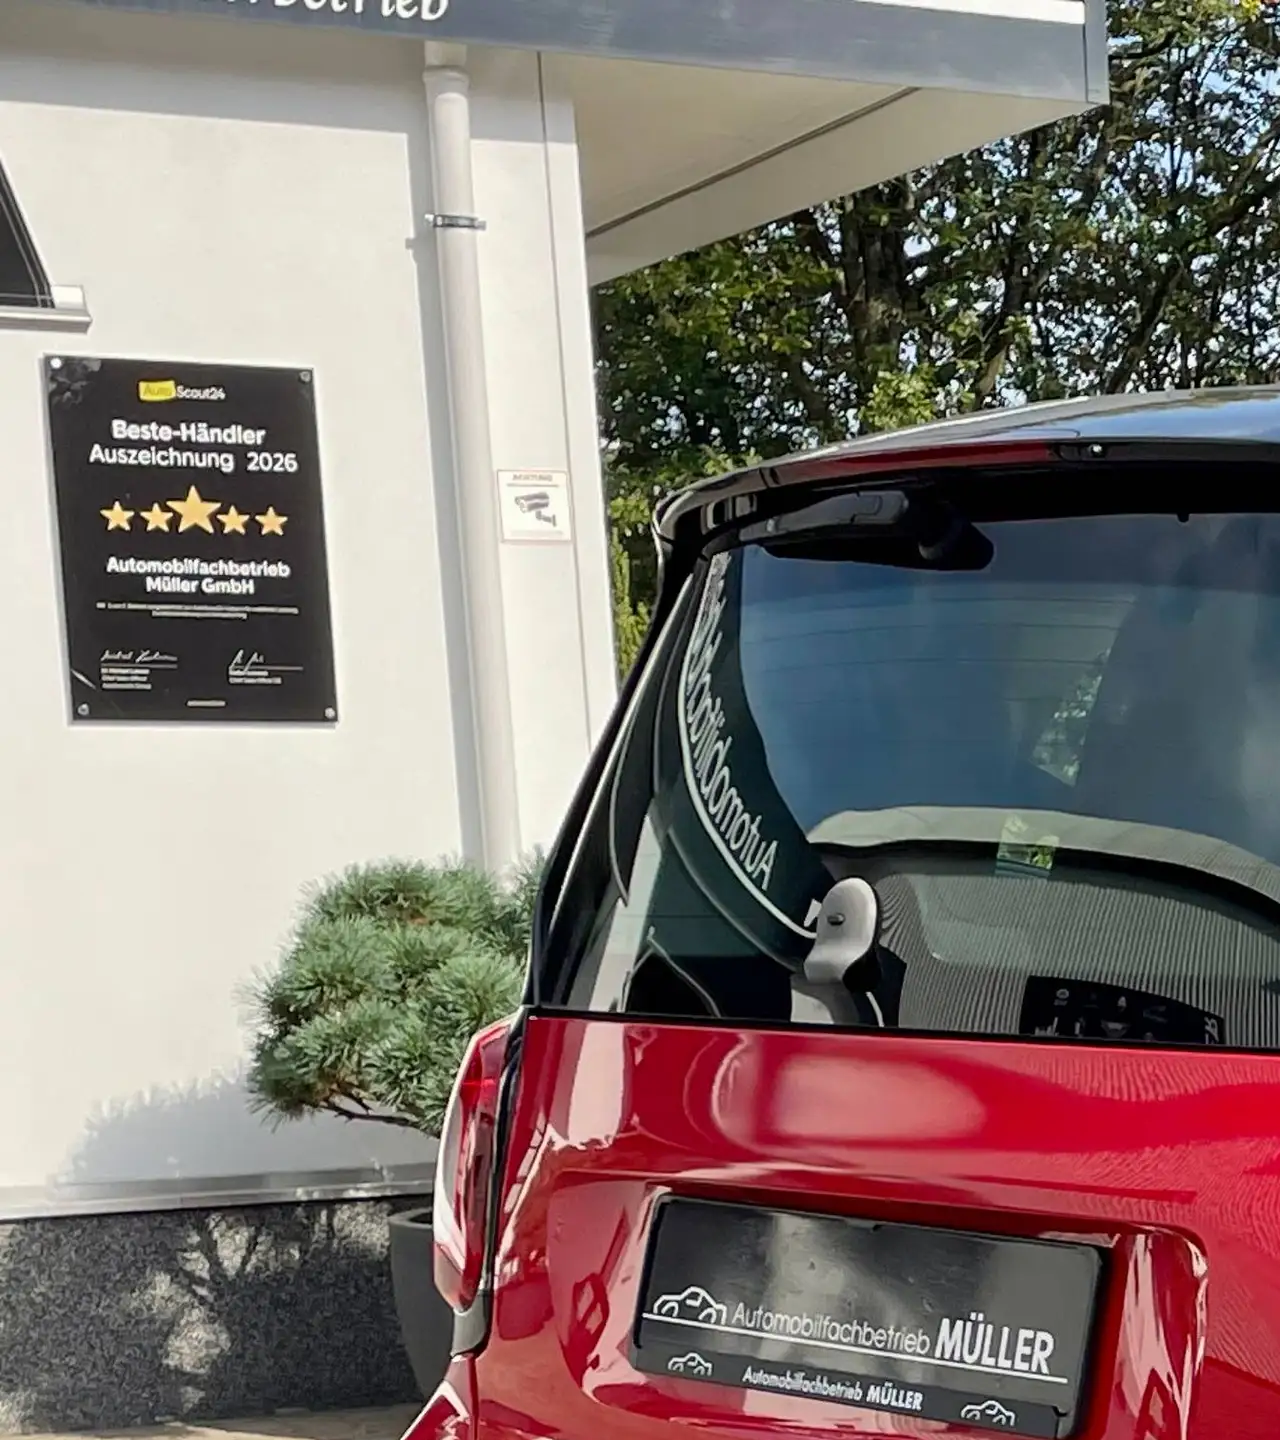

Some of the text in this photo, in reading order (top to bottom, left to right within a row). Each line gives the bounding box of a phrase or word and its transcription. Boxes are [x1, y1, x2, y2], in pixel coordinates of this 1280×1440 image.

[111, 419, 267, 445] Beste-Händler
[89, 443, 299, 473] Auszeichnung 2026
[106, 556, 292, 578] Automobilfachbetrieb
[146, 576, 256, 595] Müller GmbH
[731, 1301, 1055, 1374] Automobilfachbetrieb MÜLLER
[742, 1366, 924, 1411] Automobilfachbetrieb MÜLLER
